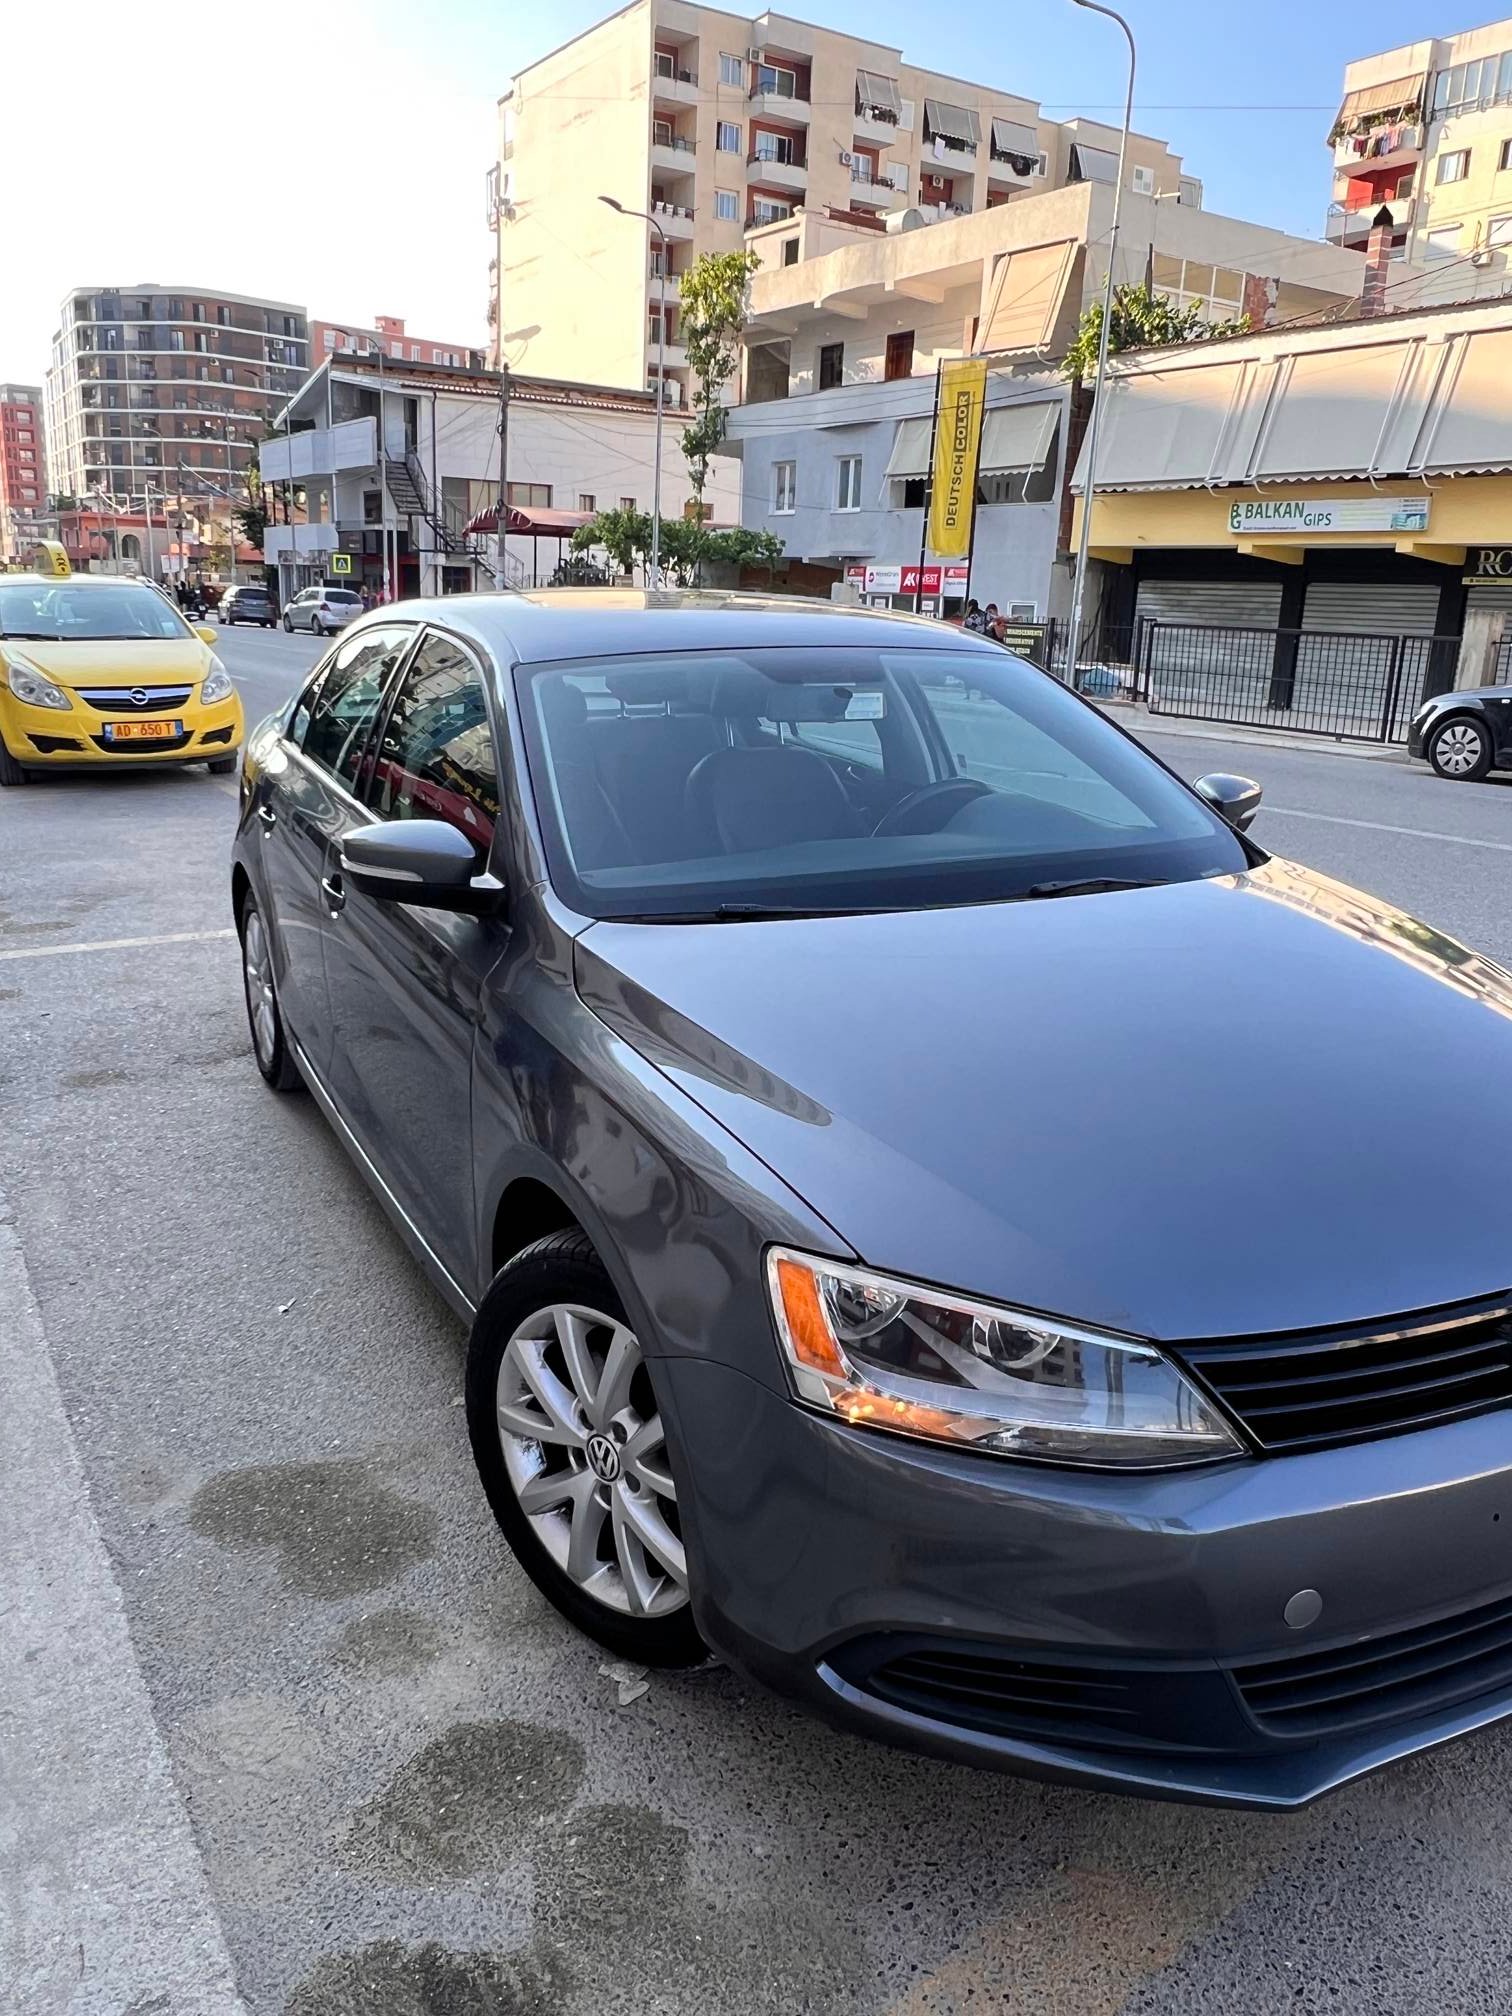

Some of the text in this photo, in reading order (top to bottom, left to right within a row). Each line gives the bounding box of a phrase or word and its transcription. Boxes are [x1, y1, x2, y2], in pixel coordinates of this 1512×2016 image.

[945, 393, 970, 527] DEUTSCH COLOR
[1245, 502, 1306, 519] BALKAN
[1304, 512, 1333, 527] GIPS
[903, 572, 916, 587] AK
[117, 723, 172, 737] AD 650 T
[588, 1436, 619, 1481] VW
